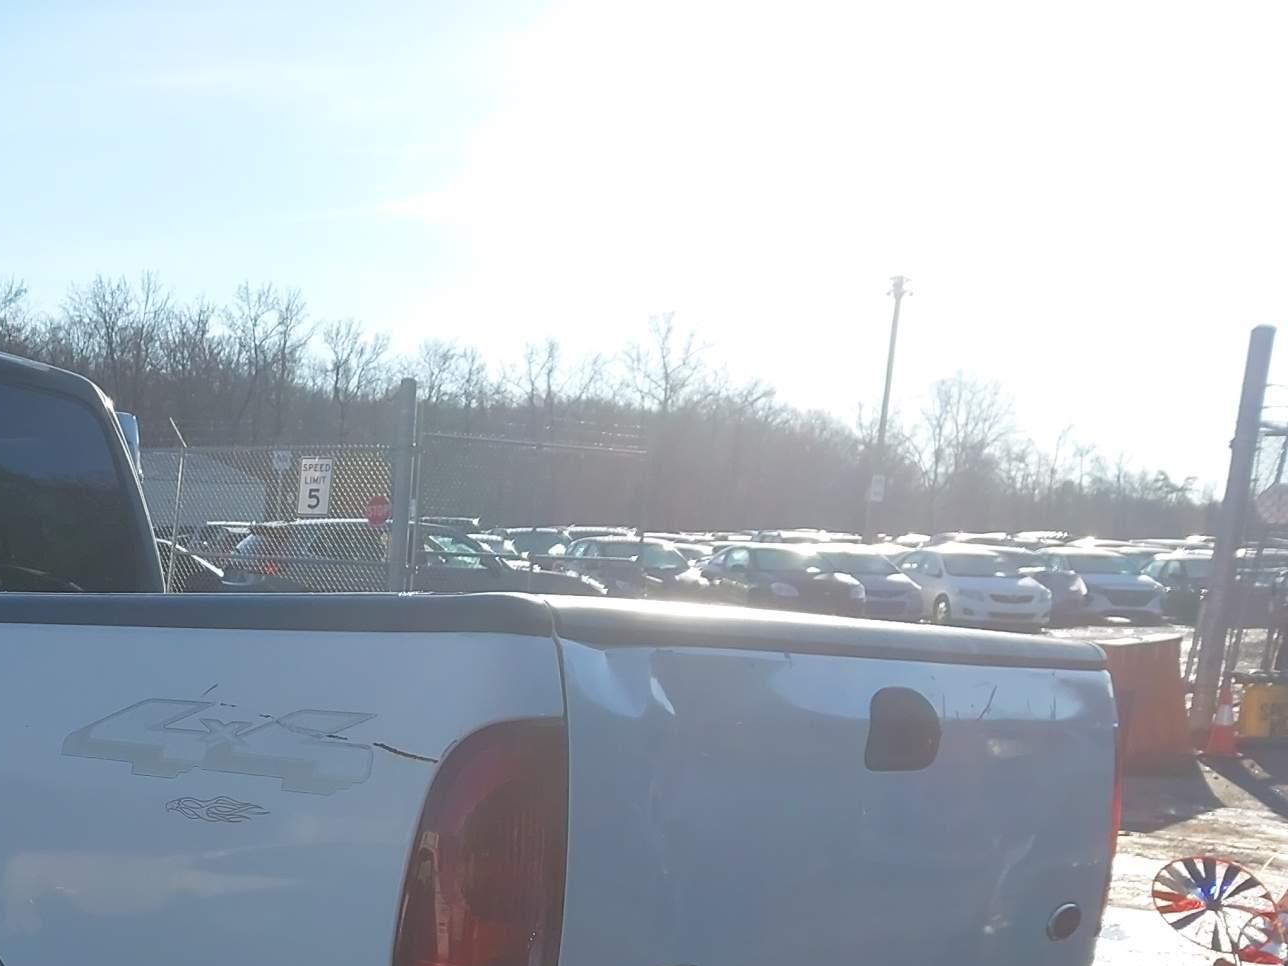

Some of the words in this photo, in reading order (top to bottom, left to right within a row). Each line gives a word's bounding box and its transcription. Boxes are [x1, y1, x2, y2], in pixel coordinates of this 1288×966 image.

[303, 463, 331, 473] SPEED
[304, 476, 327, 485] LIMIT
[307, 488, 321, 510] 5
